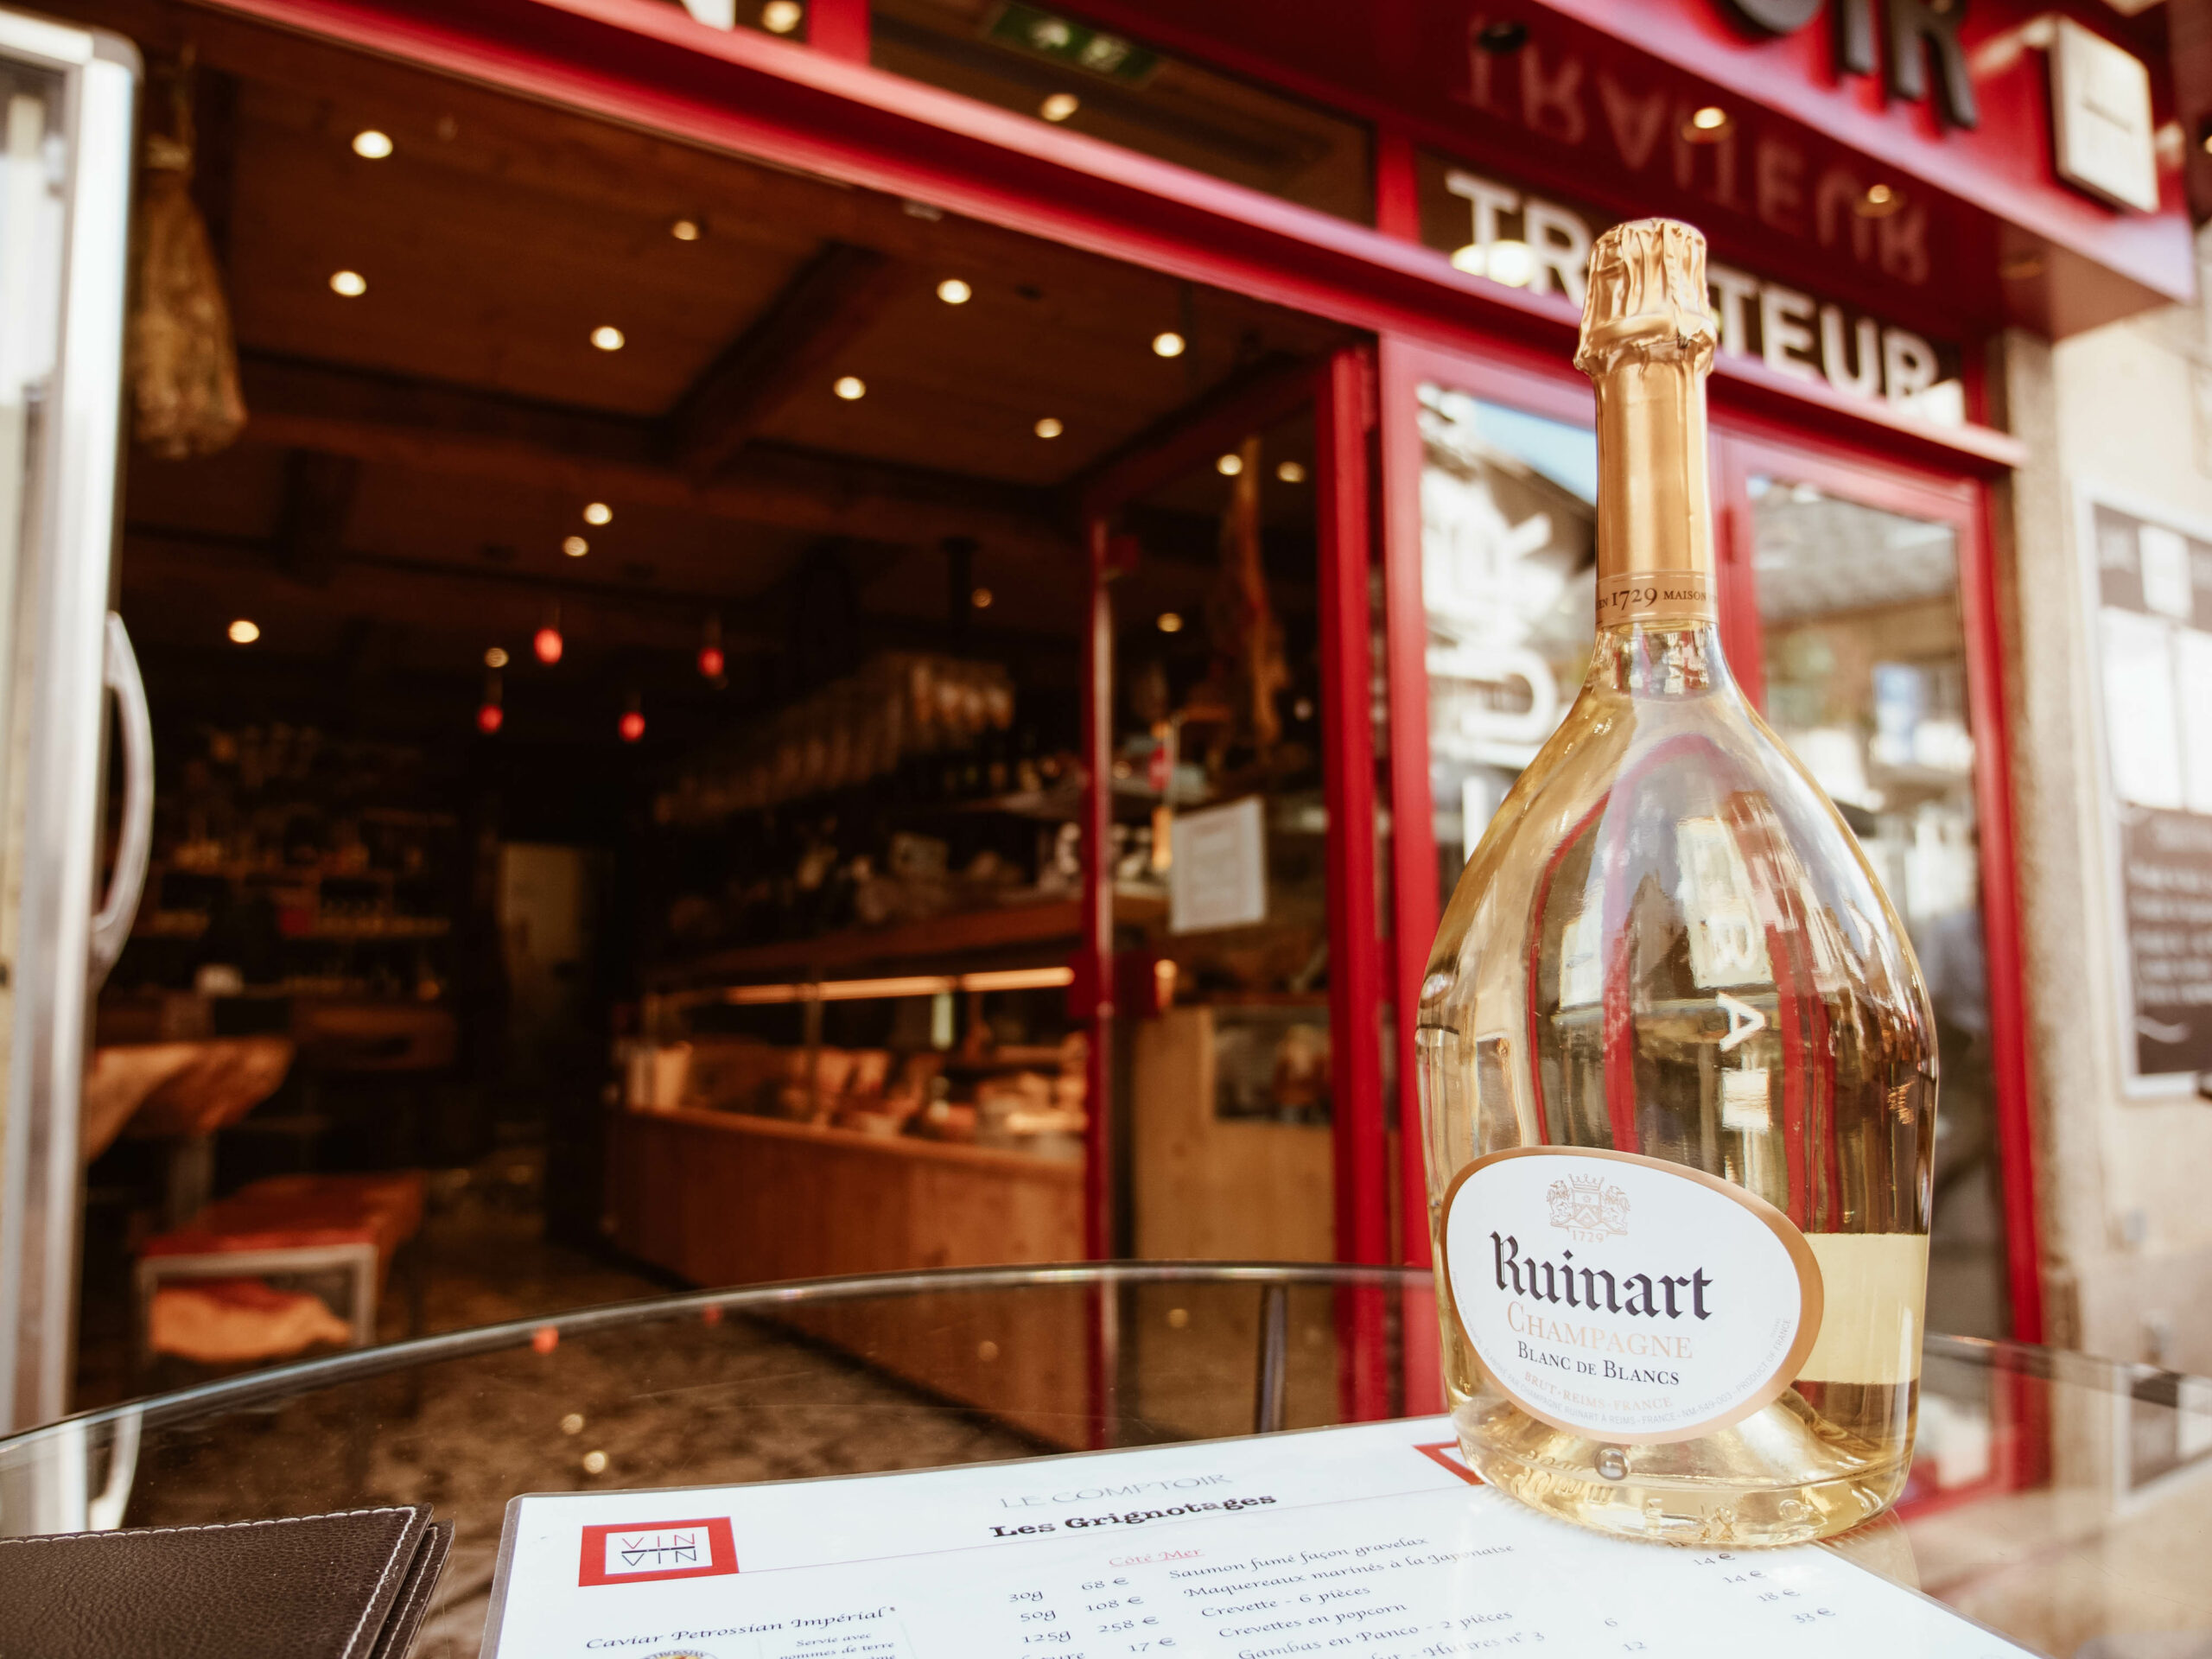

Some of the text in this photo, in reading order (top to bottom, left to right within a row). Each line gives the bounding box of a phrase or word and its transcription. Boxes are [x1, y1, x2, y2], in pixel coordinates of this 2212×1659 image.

[1445, 170, 1938, 413] TRTEUR
[1611, 588, 1657, 611] 1729
[1663, 590, 1707, 601] MAISON
[1572, 1230, 1605, 1243] 1729
[1490, 1230, 1713, 1320] Ruinart
[1508, 1300, 1694, 1359] CHAMPAGNE
[1517, 1340, 1571, 1370] BLANC
[1603, 1359, 1680, 1385] BLANCS
[1524, 1371, 1674, 1411] BRUT REIMS FRANCE
[1001, 1473, 1232, 1509] LE COMPTOIR
[989, 1495, 1277, 1537] Les Grignotages
[621, 1533, 695, 1549] VIN
[621, 1549, 697, 1567] VIN
[1109, 1547, 1203, 1567] Côté Mer
[1169, 1537, 1431, 1579] Saumon fumé façon gravelax
[1183, 1573, 1306, 1597] Maquereaux
[1312, 1562, 1384, 1580] marinés
[1404, 1556, 1425, 1567] la
[1009, 1588, 1044, 1604] 30g
[1081, 1580, 1106, 1592] 68
[1201, 1586, 1371, 1618] Crevette 6 pièces
[1020, 1610, 1057, 1622] 50g
[1085, 1599, 1120, 1612] 108
[1219, 1602, 1408, 1638] Crevettes en popcorn
[1604, 1618, 1618, 1627] 6
[586, 1635, 664, 1650] Caviar
[671, 1623, 783, 1642] Petrossian
[796, 1632, 872, 1647] Servie avec
[1023, 1630, 1071, 1643] 125g
[1098, 1619, 1135, 1633] 258
[1238, 1611, 1513, 1659] Gambas en Panco 2 pièces
[1532, 1631, 1546, 1641] 3
[841, 1644, 857, 1654] de
[862, 1642, 895, 1651] terre
[1128, 1642, 1150, 1652] 17
